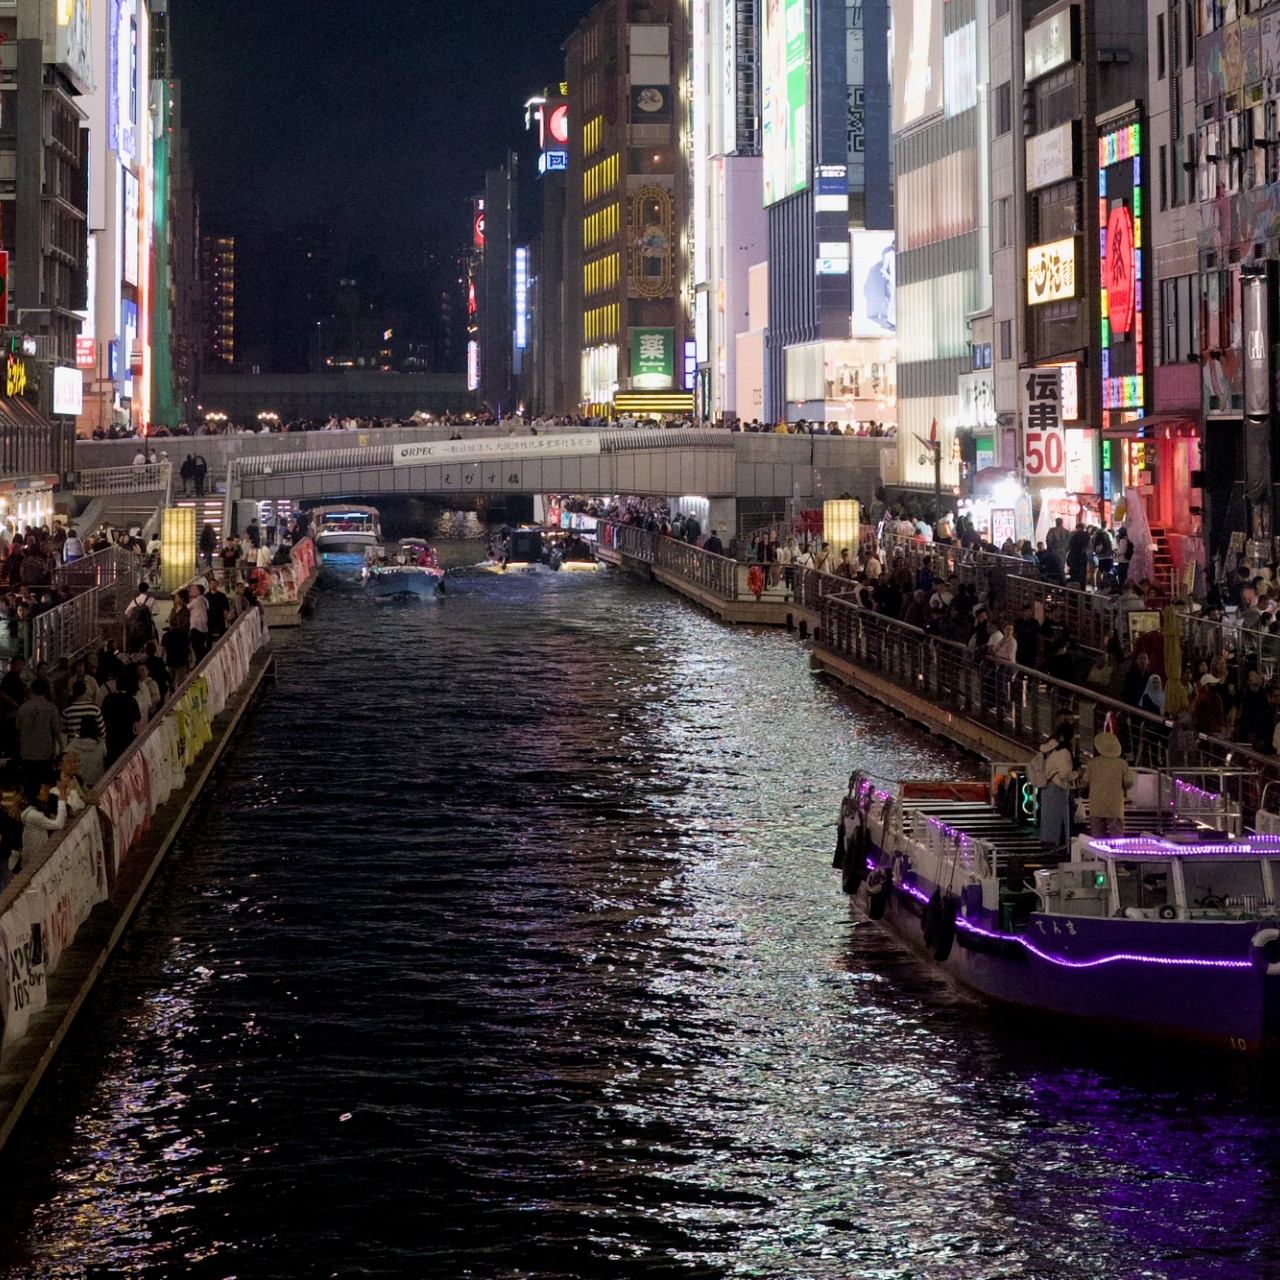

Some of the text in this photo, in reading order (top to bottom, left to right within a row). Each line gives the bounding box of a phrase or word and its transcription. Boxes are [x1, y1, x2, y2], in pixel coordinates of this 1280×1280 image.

[639, 333, 665, 360] 薬
[1026, 373, 1059, 431] 伝串
[1026, 432, 1063, 475] 50
[443, 473, 520, 486] えびす橋
[995, 527, 1014, 539] 50
